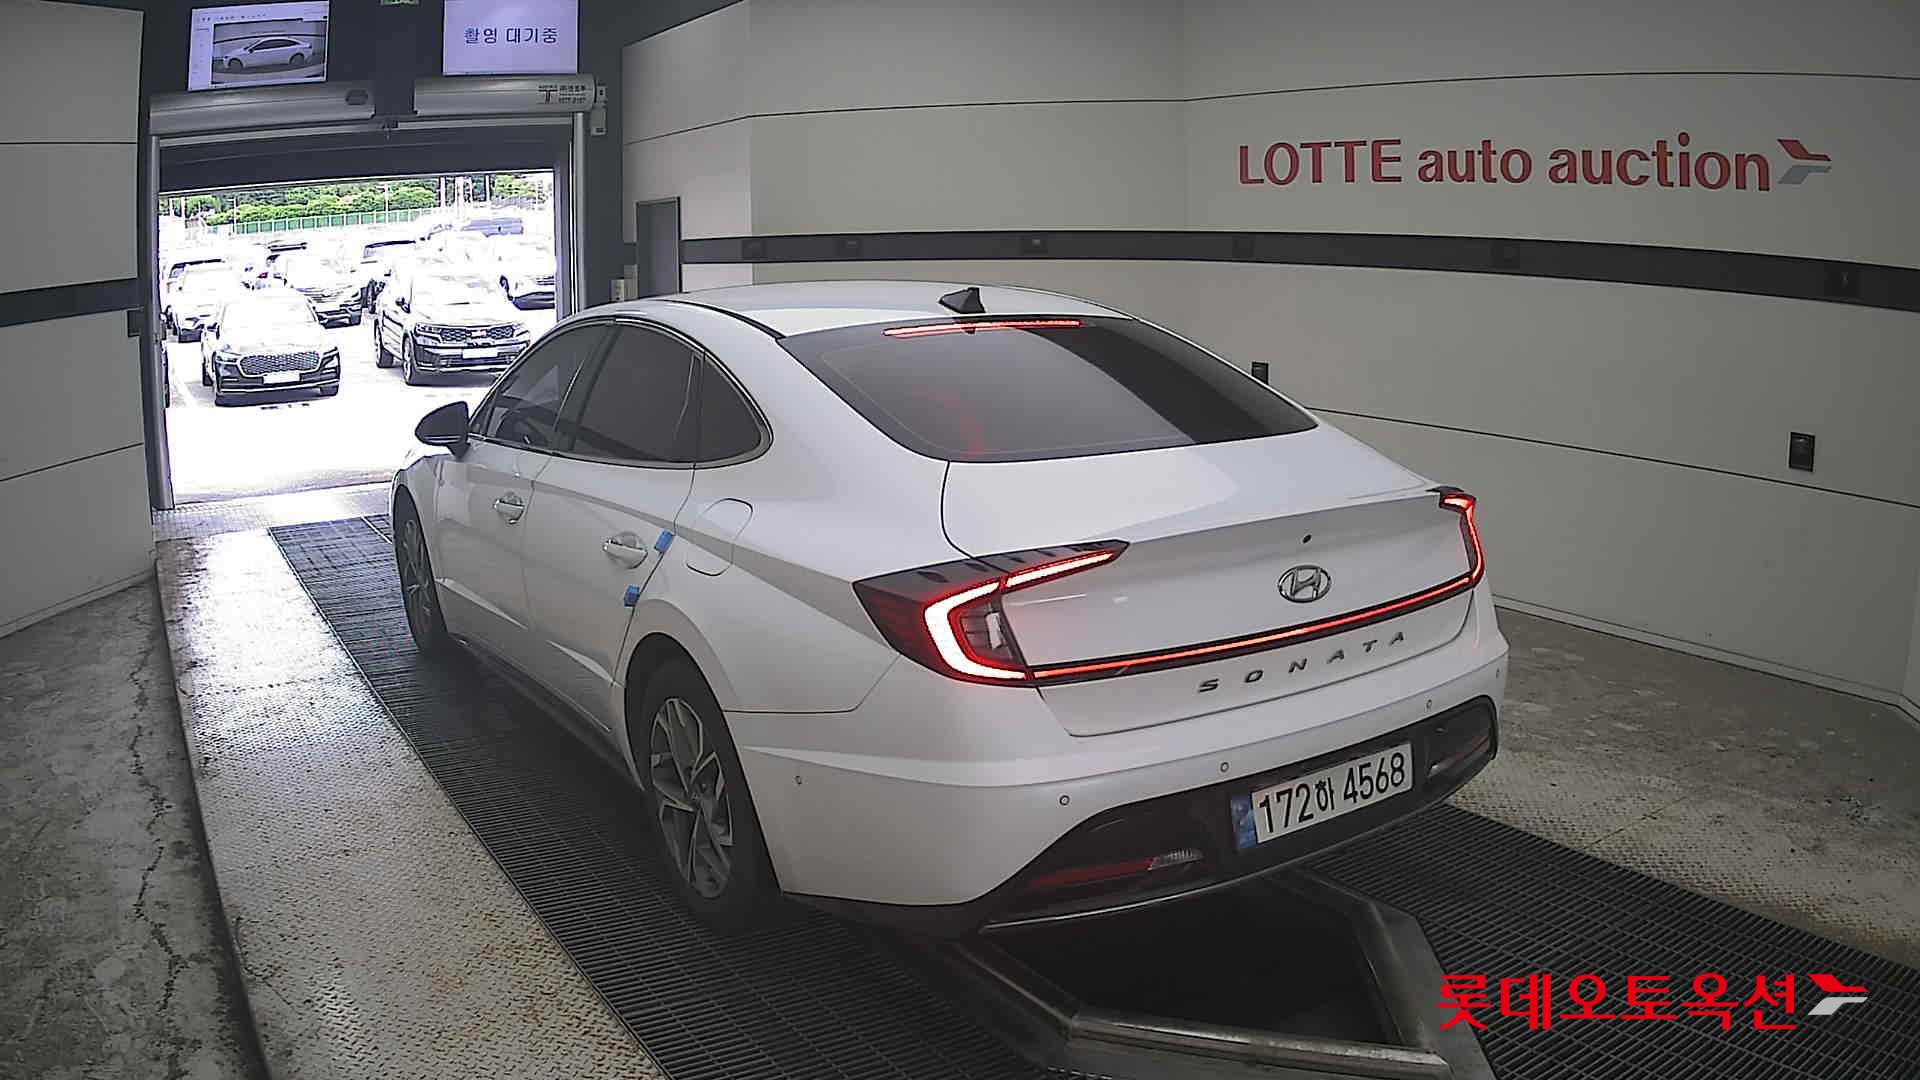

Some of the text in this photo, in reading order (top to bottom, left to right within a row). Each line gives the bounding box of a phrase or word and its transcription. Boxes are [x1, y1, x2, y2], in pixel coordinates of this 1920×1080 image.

[464, 27, 558, 44] 촬영 대기중
[1239, 132, 1771, 191] LOTTE auto auction
[1197, 631, 1405, 693] SONATA
[1258, 752, 1405, 833] 172하 4568
